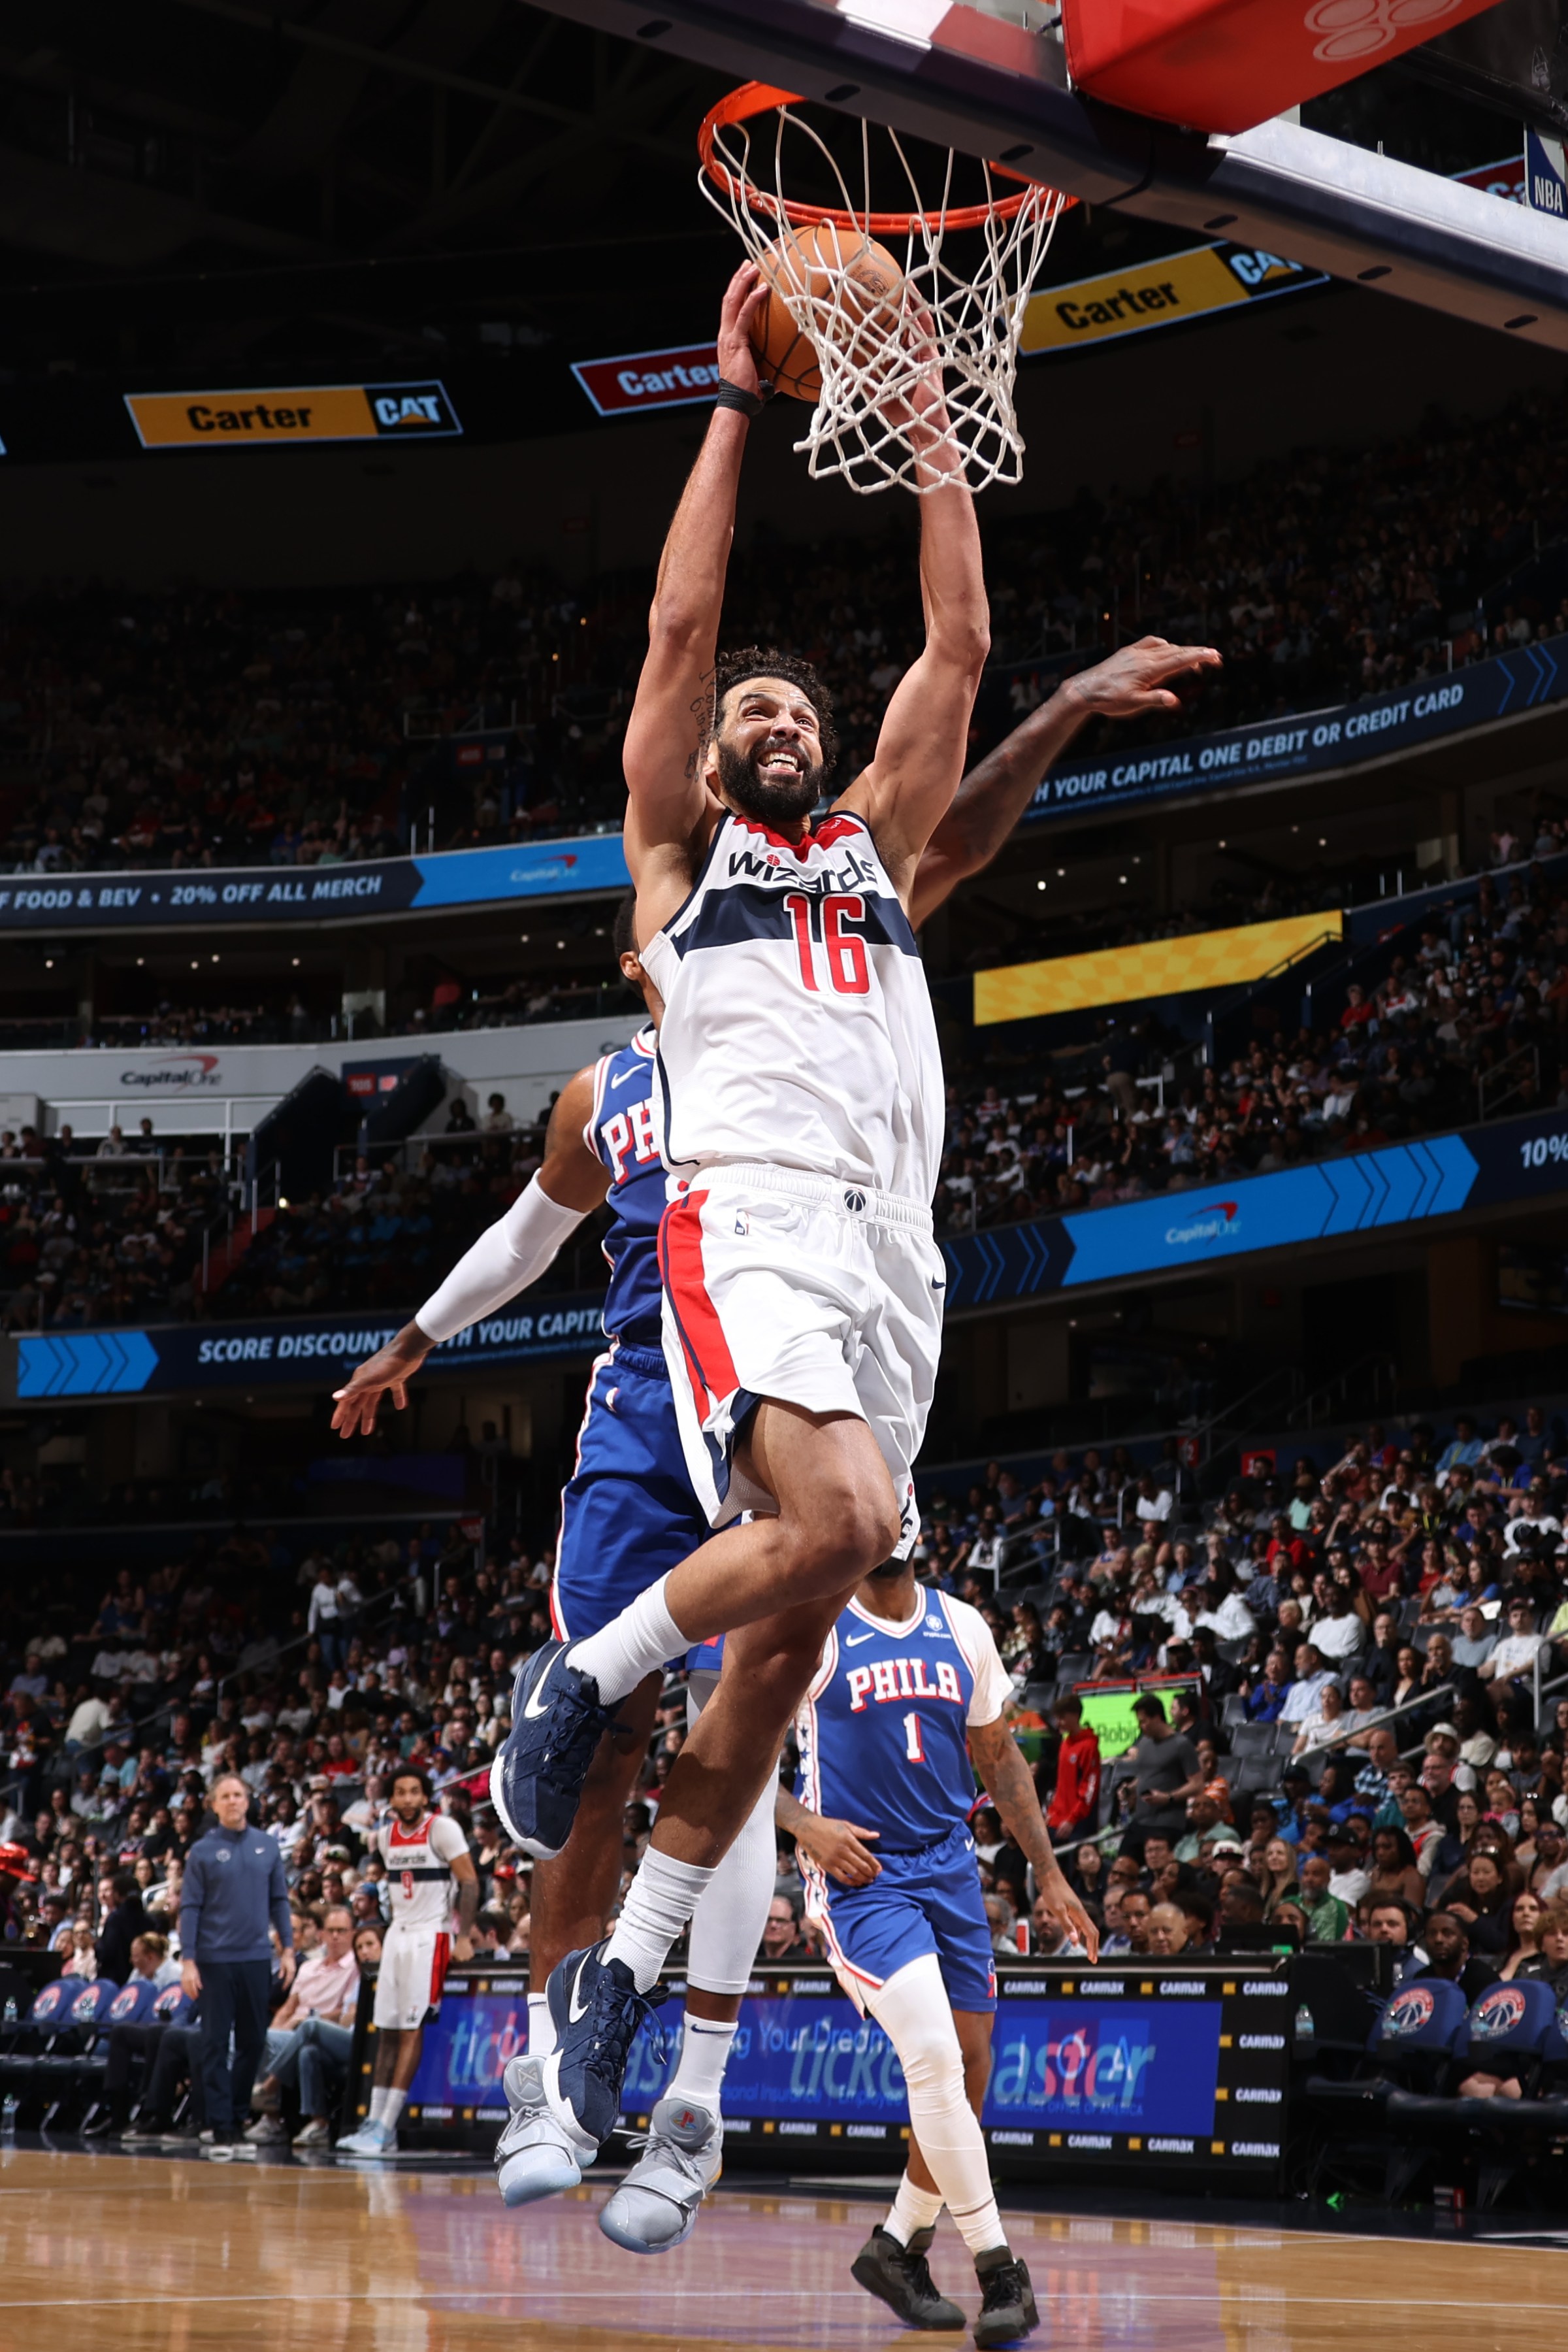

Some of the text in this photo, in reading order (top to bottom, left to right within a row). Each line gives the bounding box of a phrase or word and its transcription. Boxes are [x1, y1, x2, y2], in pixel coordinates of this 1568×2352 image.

[1055, 251, 1304, 330] Carter CA
[186, 395, 442, 432] Carter CAT
[1054, 770, 1108, 800] YOUR
[1111, 753, 1194, 791] CAPITAL
[1199, 742, 1243, 770] ONE
[1246, 729, 1309, 760] DEBIT
[1312, 722, 1342, 748] OR
[1345, 700, 1411, 738] CREDIT
[1413, 684, 1464, 718] CARD
[13, 889, 73, 910] FOOD
[76, 889, 93, 908] &
[98, 888, 142, 908] BEV
[170, 885, 218, 905] 20%
[221, 884, 264, 903] OFF
[267, 882, 307, 902] ALL
[312, 875, 383, 901] MERCH
[783, 891, 871, 998] 16
[1520, 1132, 1568, 1169] 10%
[198, 1336, 273, 1363] SCORE
[478, 1318, 532, 1344] YOUR
[1535, 1482, 1563, 1521] NBA
[846, 1658, 964, 1714] PHILA
[903, 1712, 926, 1763] 1
[401, 1870, 414, 1900] 9
[759, 2021, 808, 2053] Your
